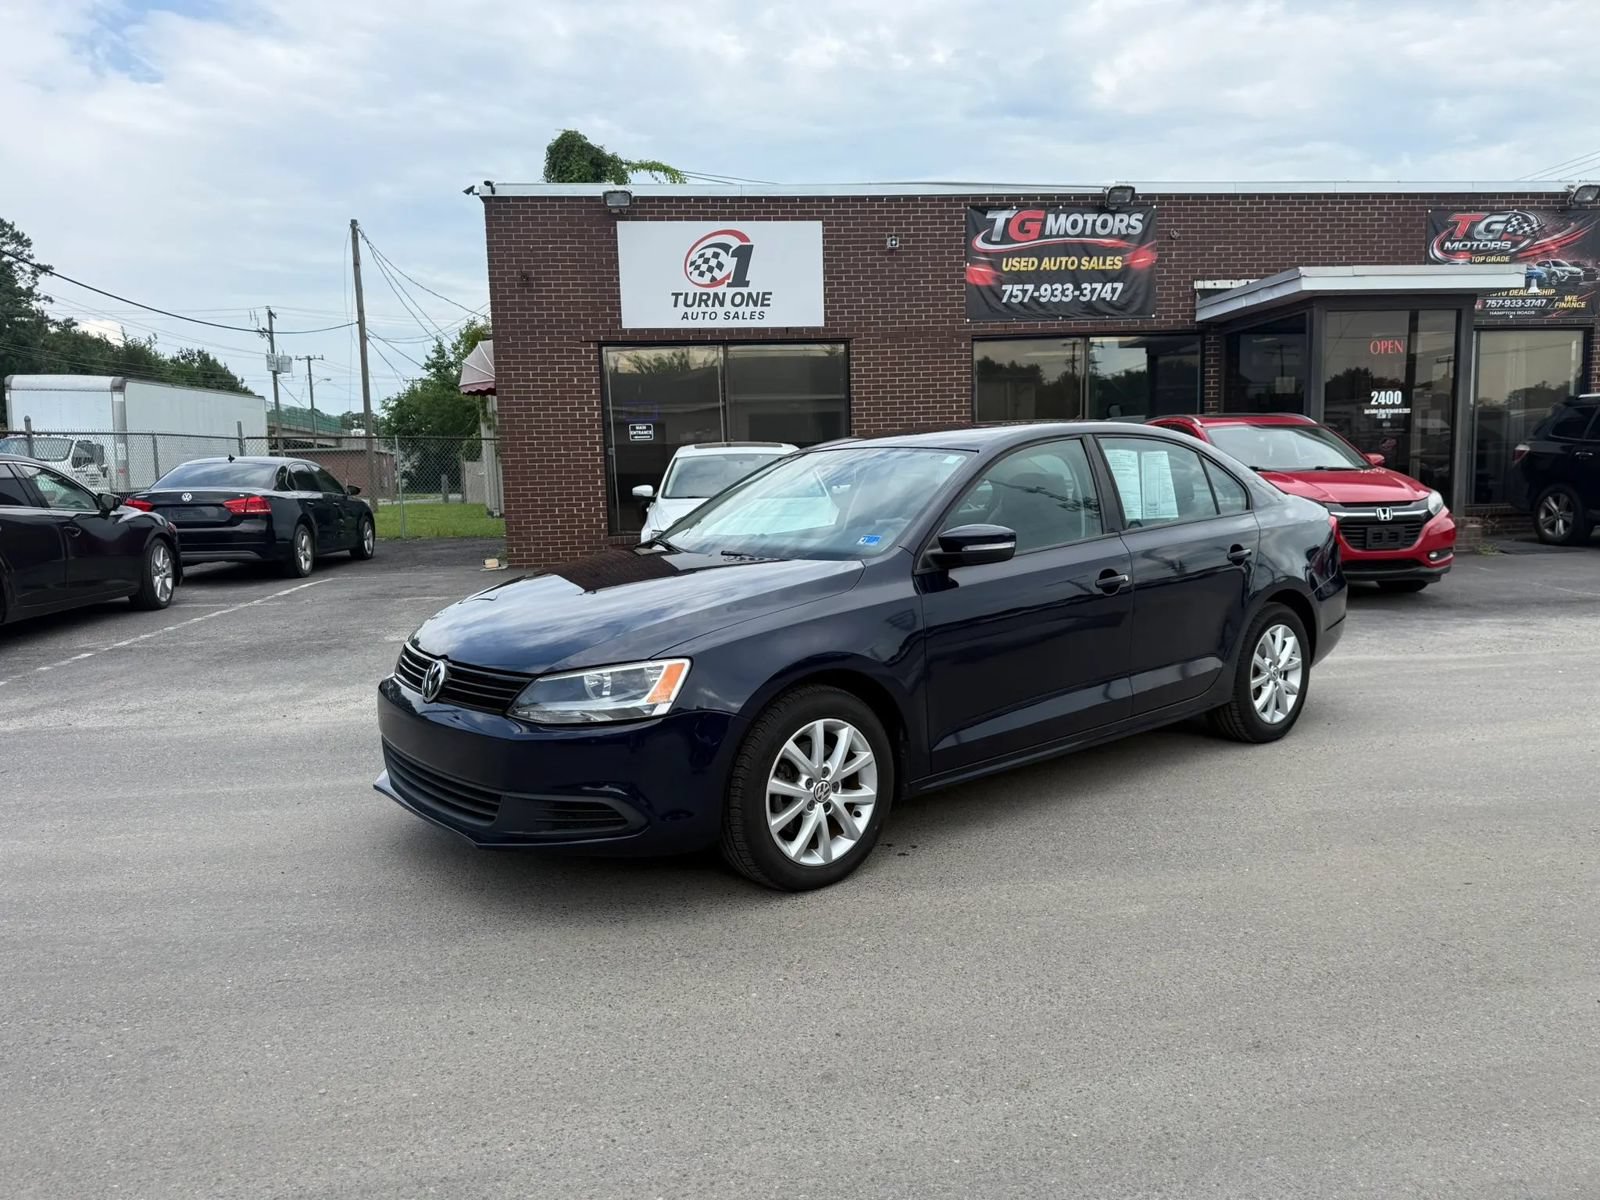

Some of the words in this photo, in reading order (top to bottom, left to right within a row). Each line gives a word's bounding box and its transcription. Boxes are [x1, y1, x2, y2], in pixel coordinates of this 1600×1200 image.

[986, 210, 1046, 242] TG
[1044, 213, 1144, 236] MOTORS
[1443, 241, 1512, 251] MOTORS
[1002, 257, 1038, 272] USED
[1040, 256, 1078, 271] AUTO
[1080, 256, 1123, 270] SALES
[1486, 255, 1510, 263] GRADE
[671, 292, 726, 308] TURN
[730, 291, 773, 308] ONE
[1001, 282, 1124, 304] 757-933-3747
[1509, 289, 1556, 297] DEALSHIP
[1485, 299, 1547, 308] 757-933-3747
[681, 311, 718, 321] AUTO
[723, 311, 765, 320] SALES
[1370, 340, 1404, 355] OPEN
[1370, 390, 1402, 405] 2400
